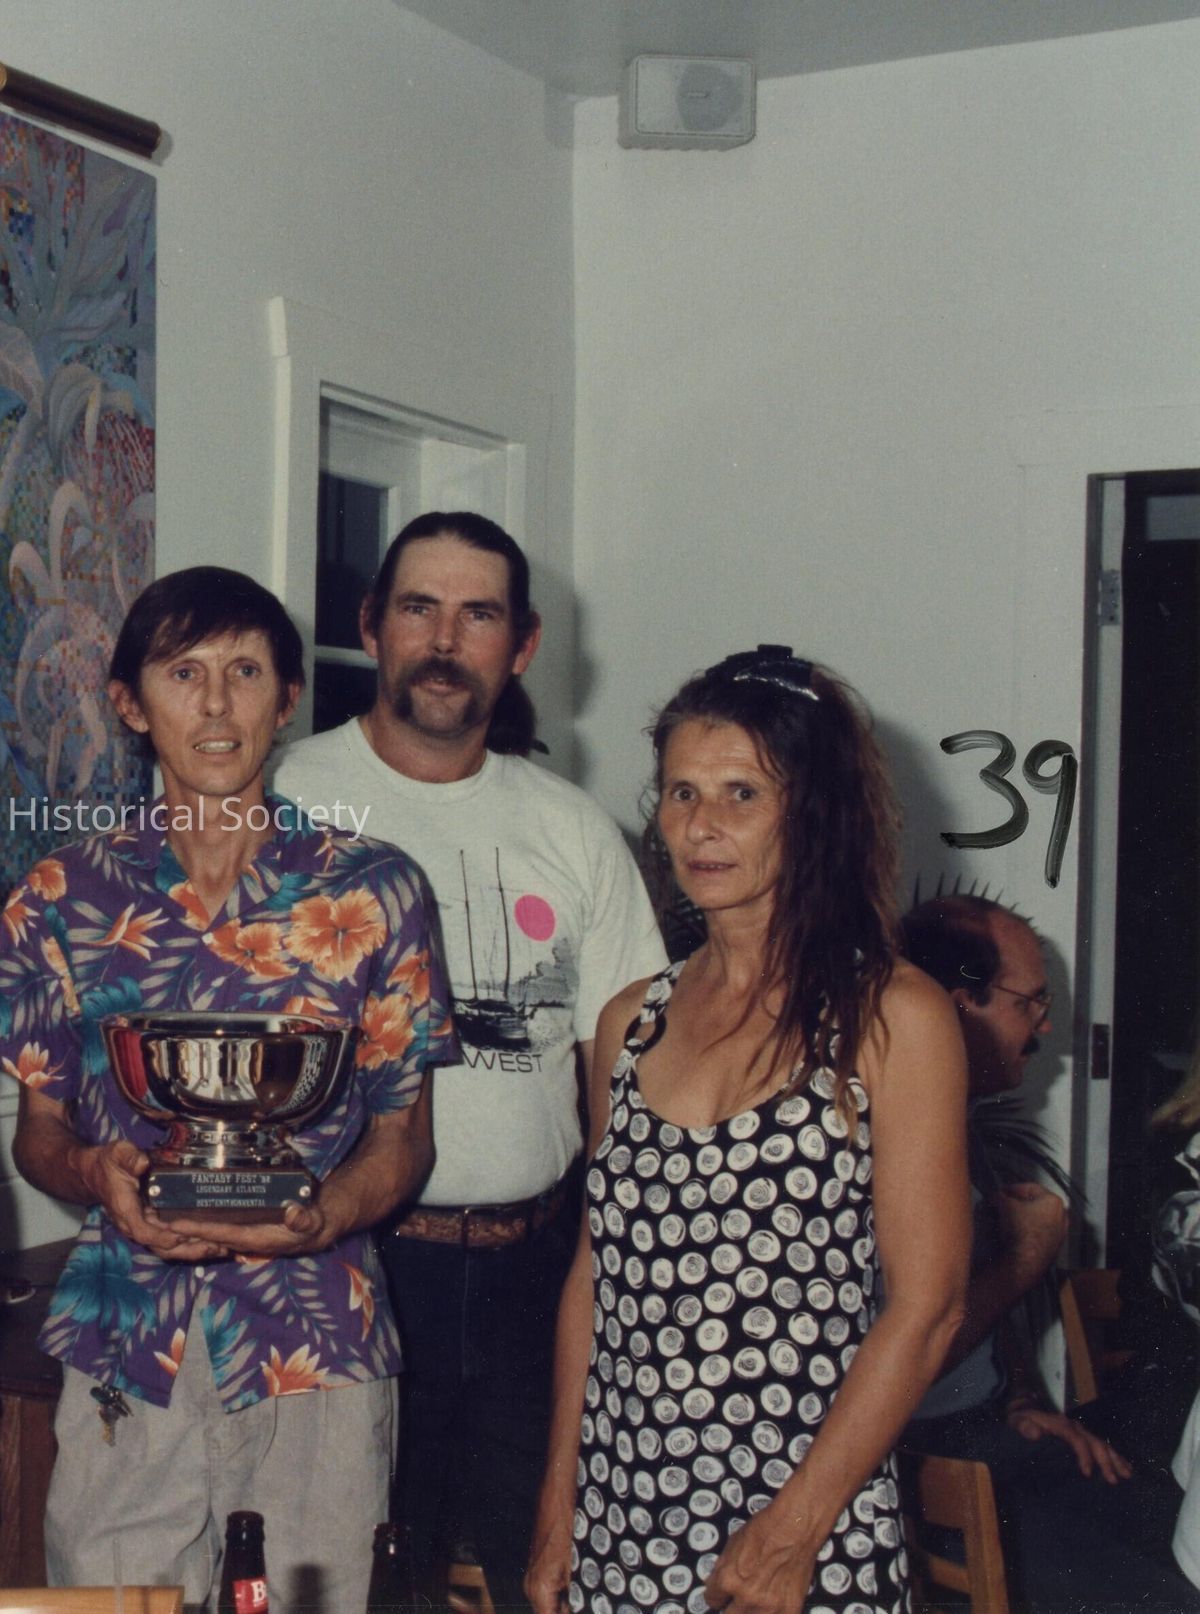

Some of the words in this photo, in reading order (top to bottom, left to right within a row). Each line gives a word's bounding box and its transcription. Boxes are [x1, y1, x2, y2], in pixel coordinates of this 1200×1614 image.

[939, 729, 1078, 888] 39
[461, 1049, 543, 1073] WEST
[191, 1174, 232, 1183] FANTASY
[236, 1174, 257, 1183] FEST
[196, 1185, 232, 1193] LEGENDARY
[236, 1185, 266, 1193] ATLANTIS
